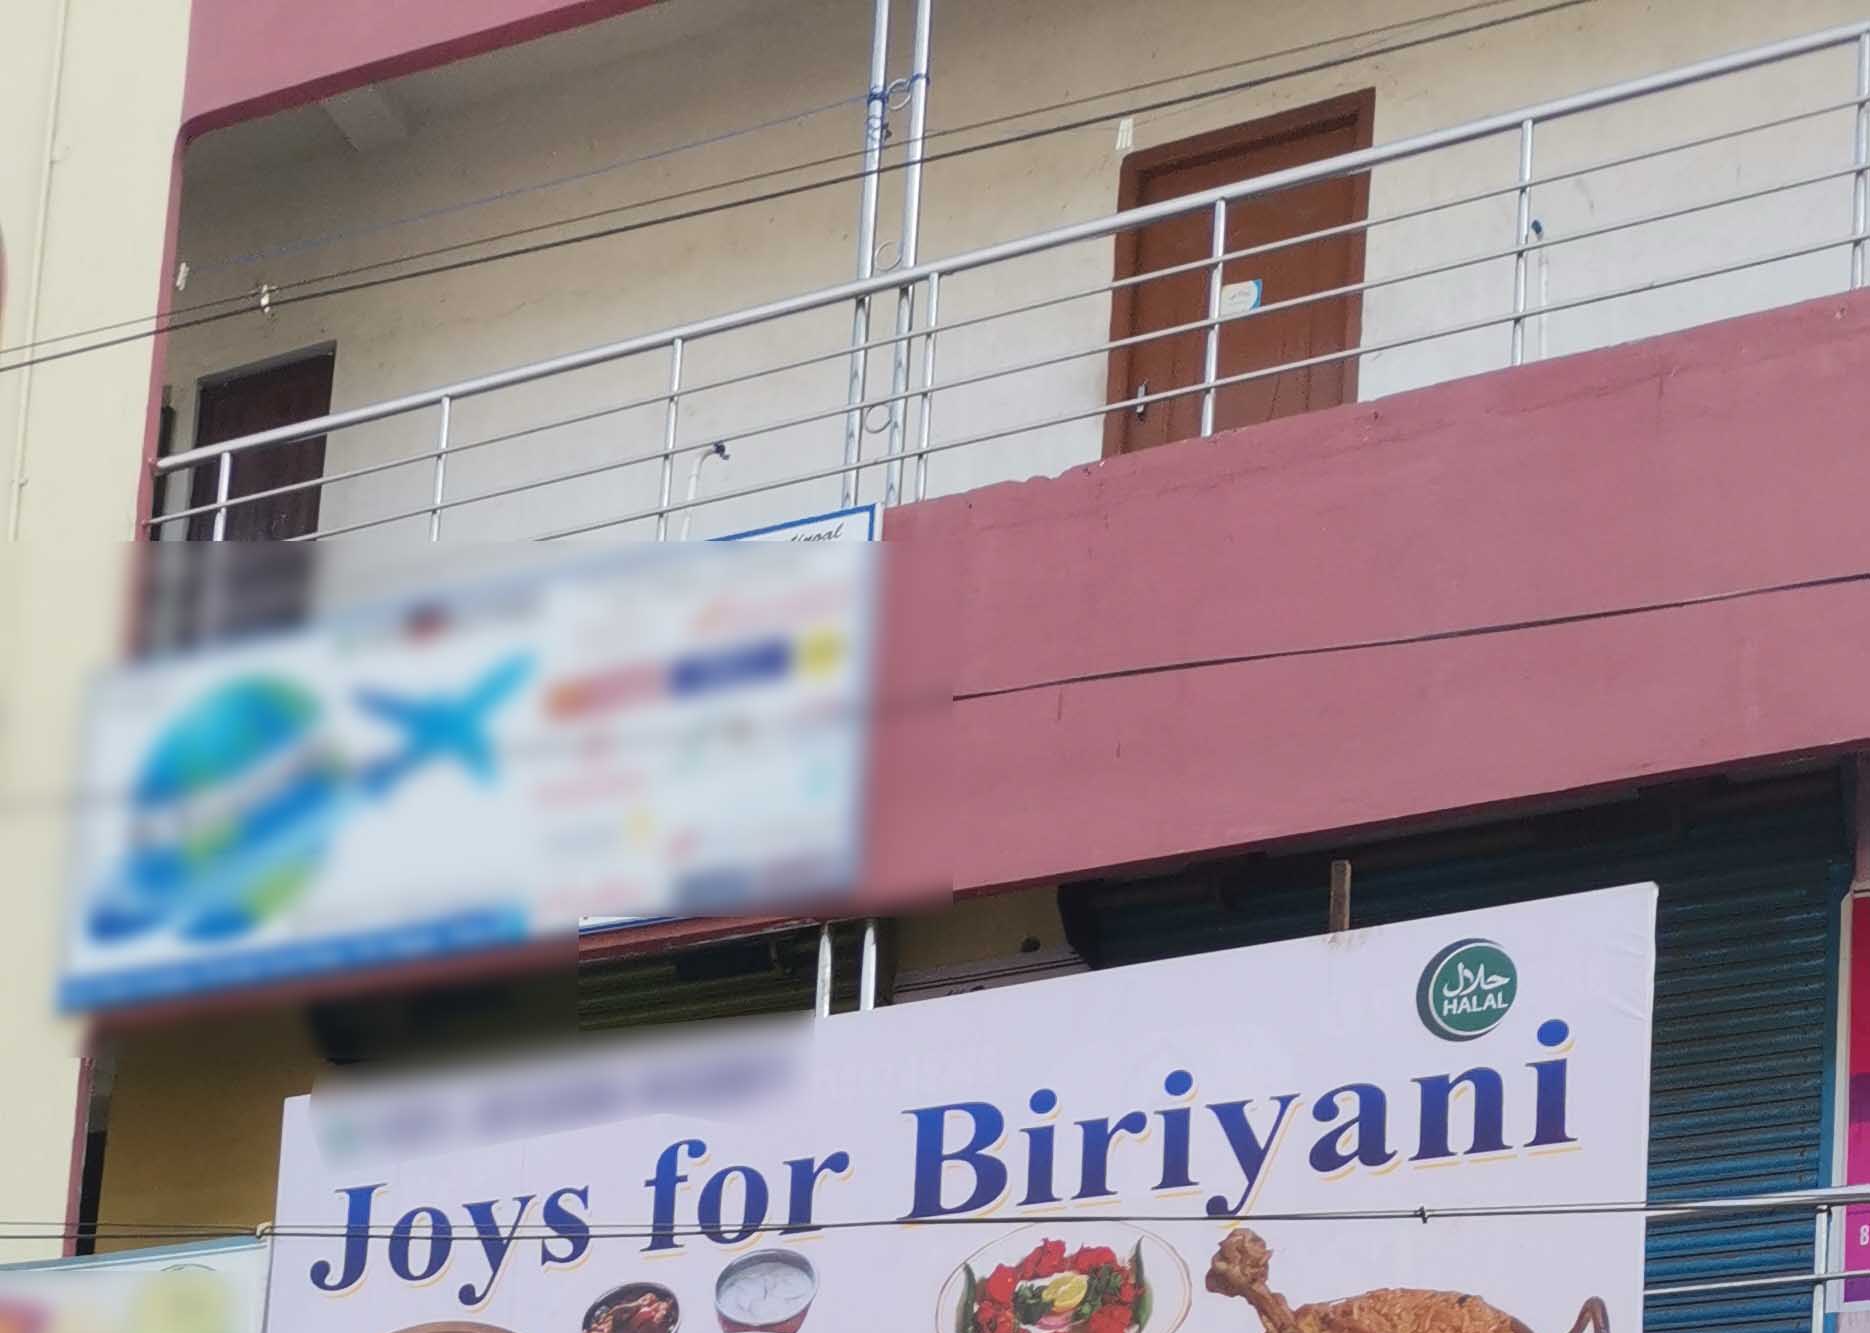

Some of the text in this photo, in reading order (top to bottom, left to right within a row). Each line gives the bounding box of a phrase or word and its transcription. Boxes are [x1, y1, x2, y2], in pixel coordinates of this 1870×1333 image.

[1442, 961, 1511, 998] حلال
[1442, 991, 1509, 1017] HALAL
[309, 1182, 590, 1307] Joys
[640, 1138, 850, 1253] for
[896, 1018, 1579, 1219] Biriyani
